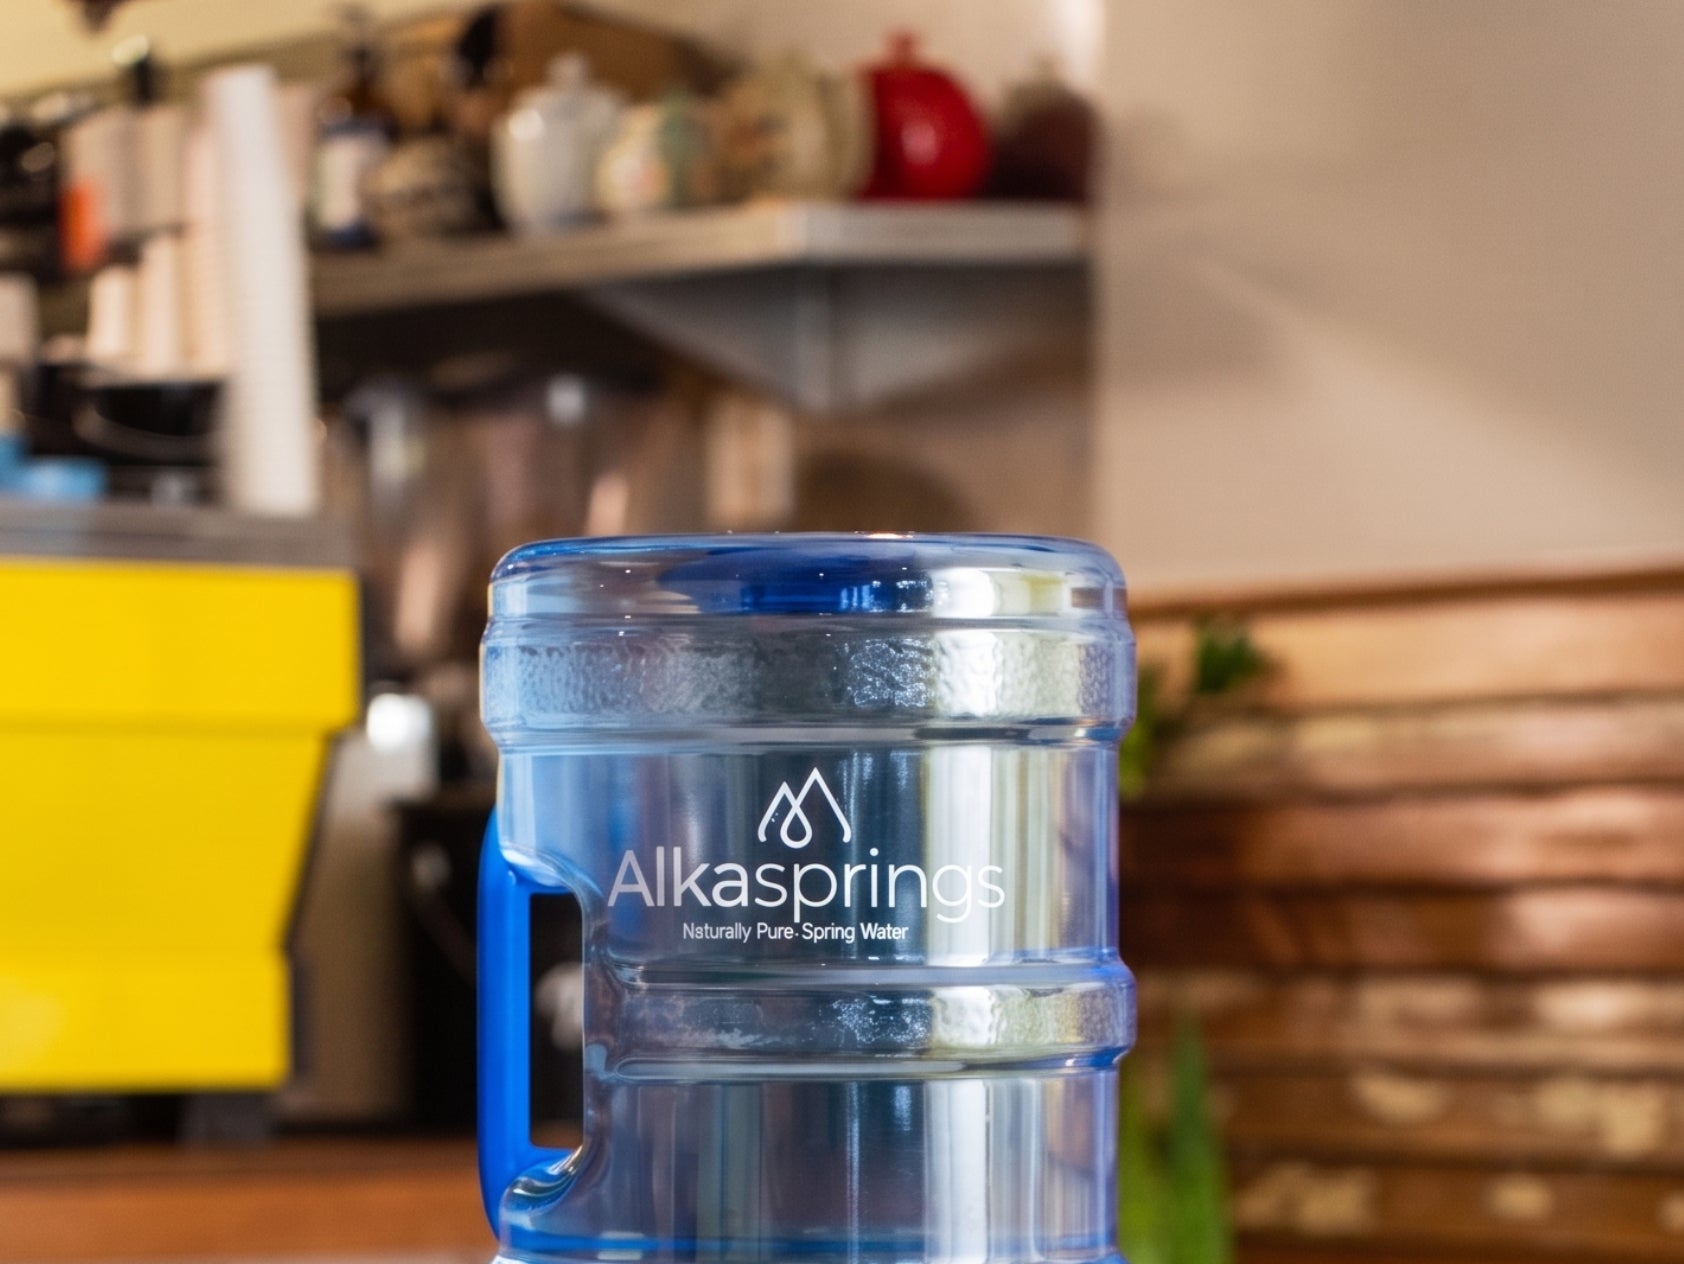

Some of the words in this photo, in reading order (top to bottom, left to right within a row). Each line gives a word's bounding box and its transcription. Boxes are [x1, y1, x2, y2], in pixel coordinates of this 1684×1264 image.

[607, 846, 1006, 924] Alkasprings
[802, 922, 855, 943] Spring
[860, 922, 909, 940] Water
